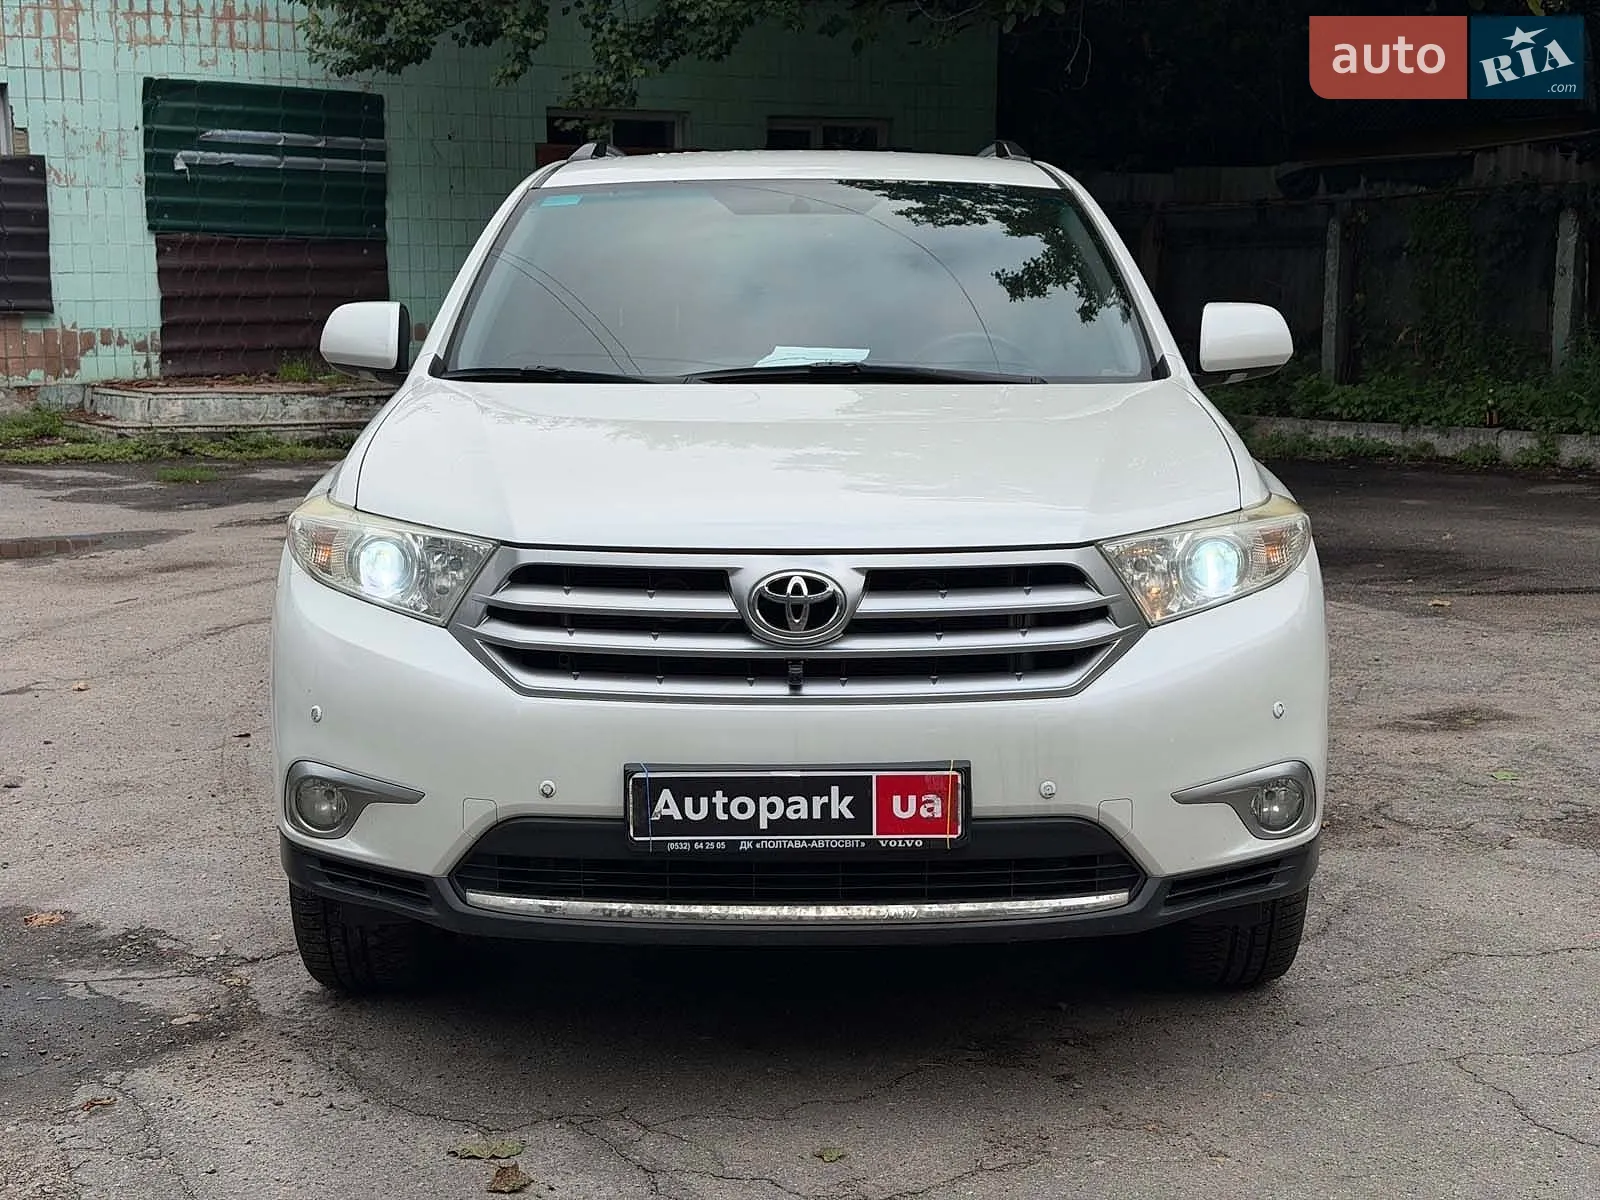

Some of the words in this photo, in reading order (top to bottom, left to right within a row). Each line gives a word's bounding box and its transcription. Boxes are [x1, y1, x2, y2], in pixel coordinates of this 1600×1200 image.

[651, 786, 854, 829] Autopark
[892, 793, 942, 818] ua
[667, 842, 691, 851] (0532)
[694, 842, 704, 850] 64
[705, 842, 714, 850] 25
[716, 842, 726, 850] 05
[739, 840, 753, 850] ДК
[879, 839, 923, 847] VOLVO
